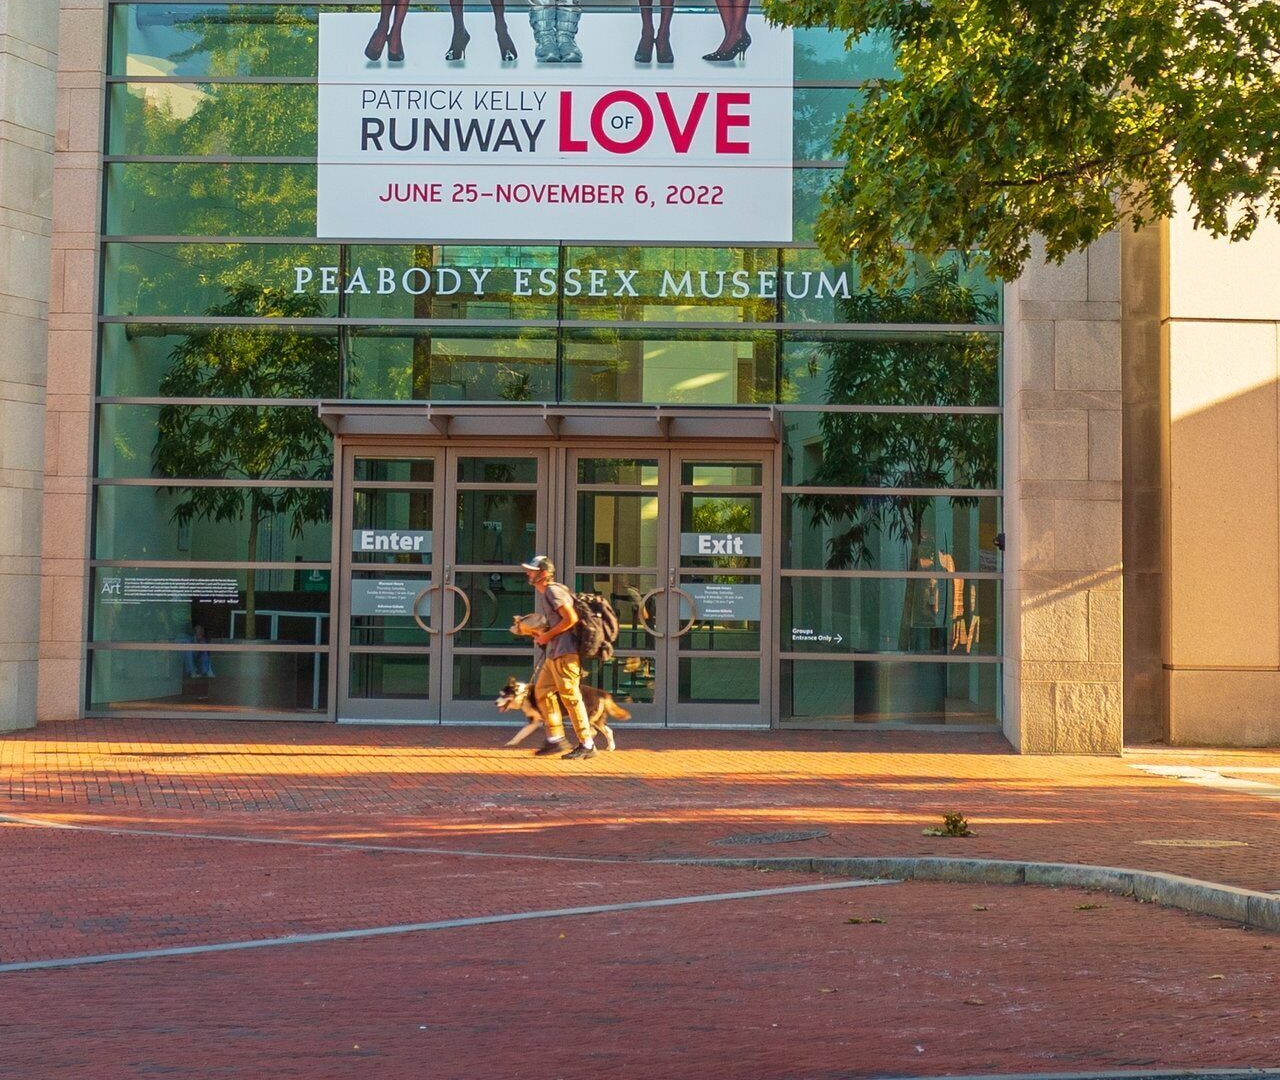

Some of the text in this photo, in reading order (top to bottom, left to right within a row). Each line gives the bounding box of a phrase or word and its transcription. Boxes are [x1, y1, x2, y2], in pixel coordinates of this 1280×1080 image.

[361, 89, 547, 111] PATRICK KELLY
[360, 89, 751, 154] RUNWAY OF LOVE
[378, 183, 442, 203] JUNE
[634, 185, 656, 208] 6,
[665, 185, 724, 205] 2022
[293, 266, 852, 300] PEABODY ESSEX MUSEUM
[361, 530, 424, 551] Enter
[698, 534, 744, 555] Exit
[101, 582, 121, 595] Art
[818, 634, 833, 642] Only
